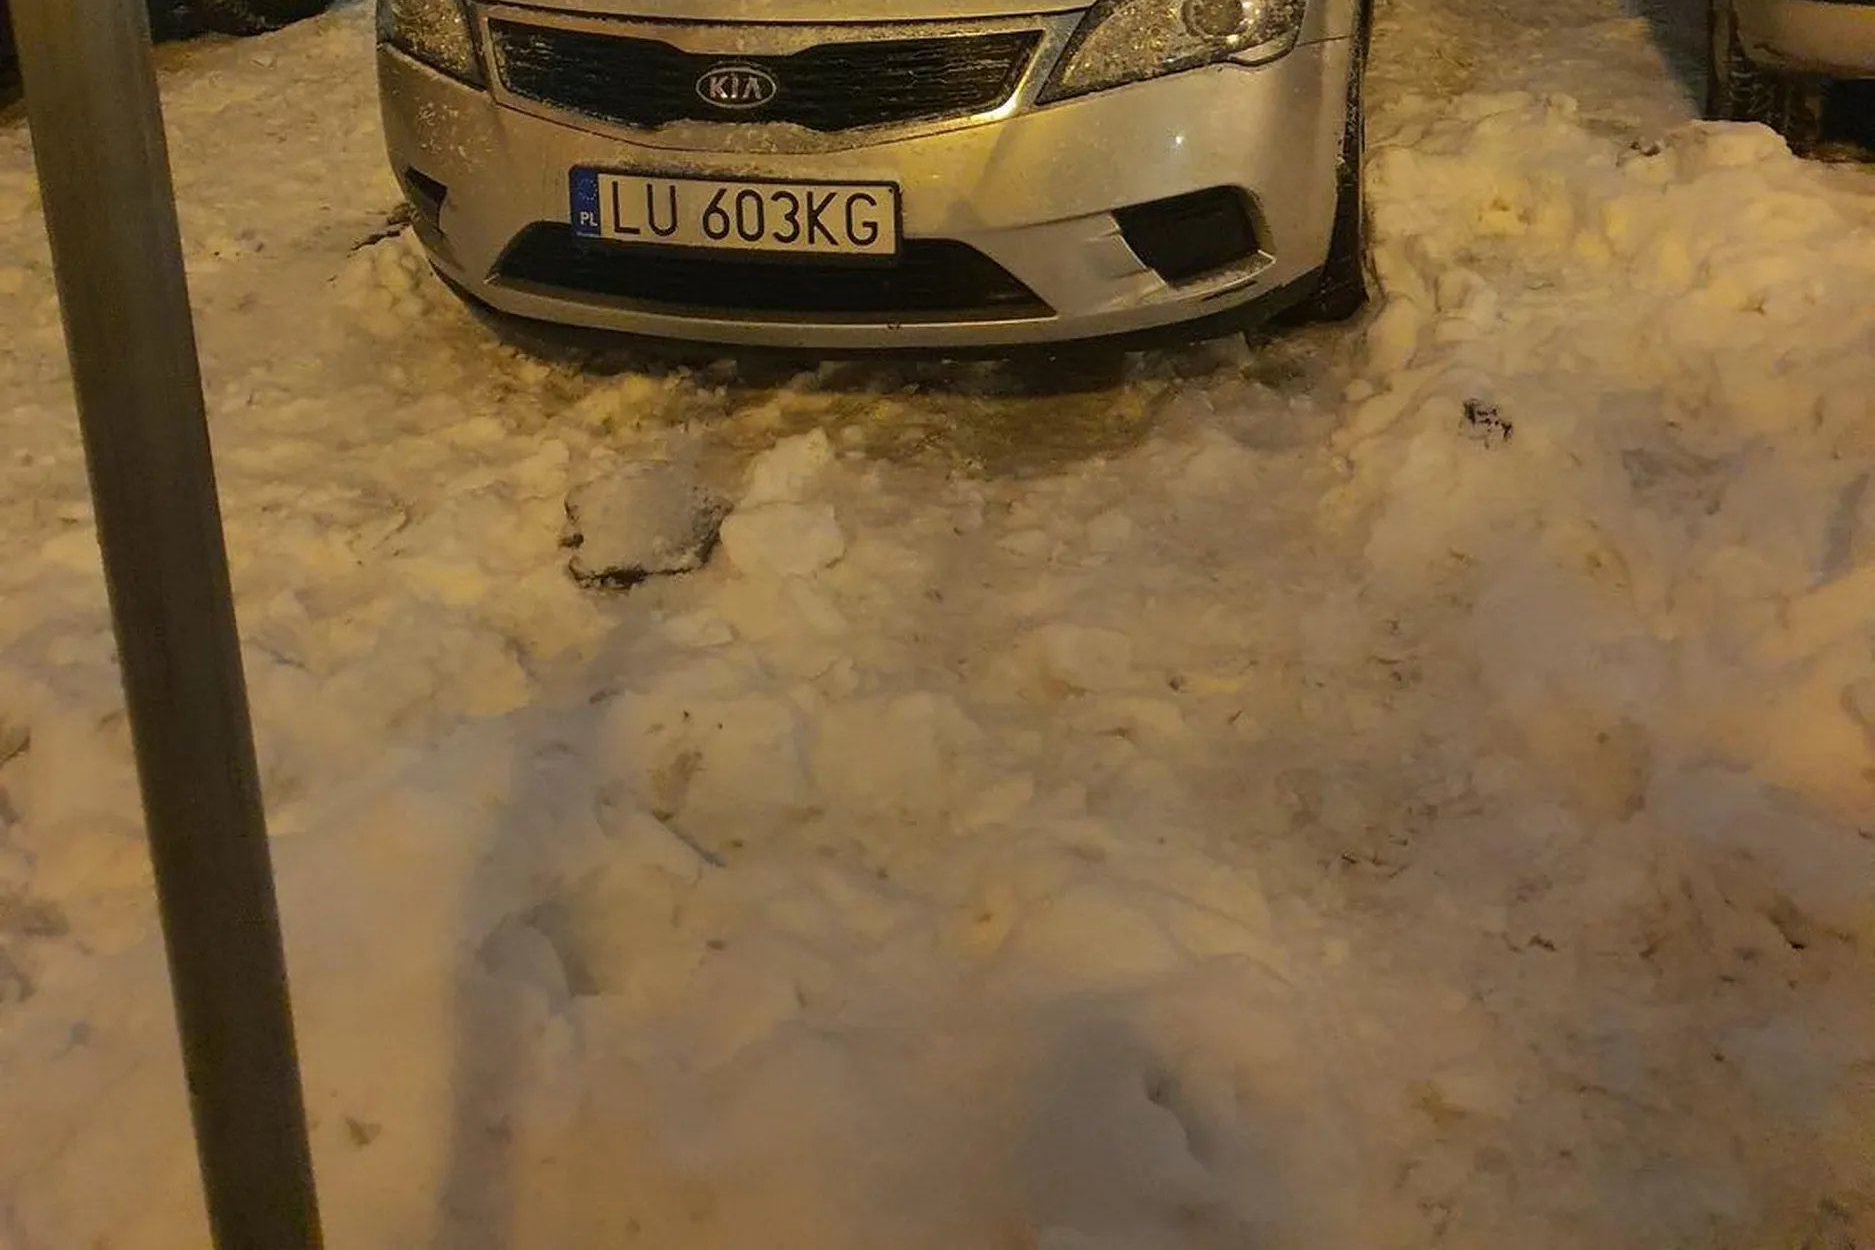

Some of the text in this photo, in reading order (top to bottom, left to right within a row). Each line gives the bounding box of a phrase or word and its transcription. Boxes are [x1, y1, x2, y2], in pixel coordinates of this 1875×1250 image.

[709, 75, 762, 99] KIA
[580, 211, 598, 227] PL
[612, 181, 879, 247] LU 603KG
